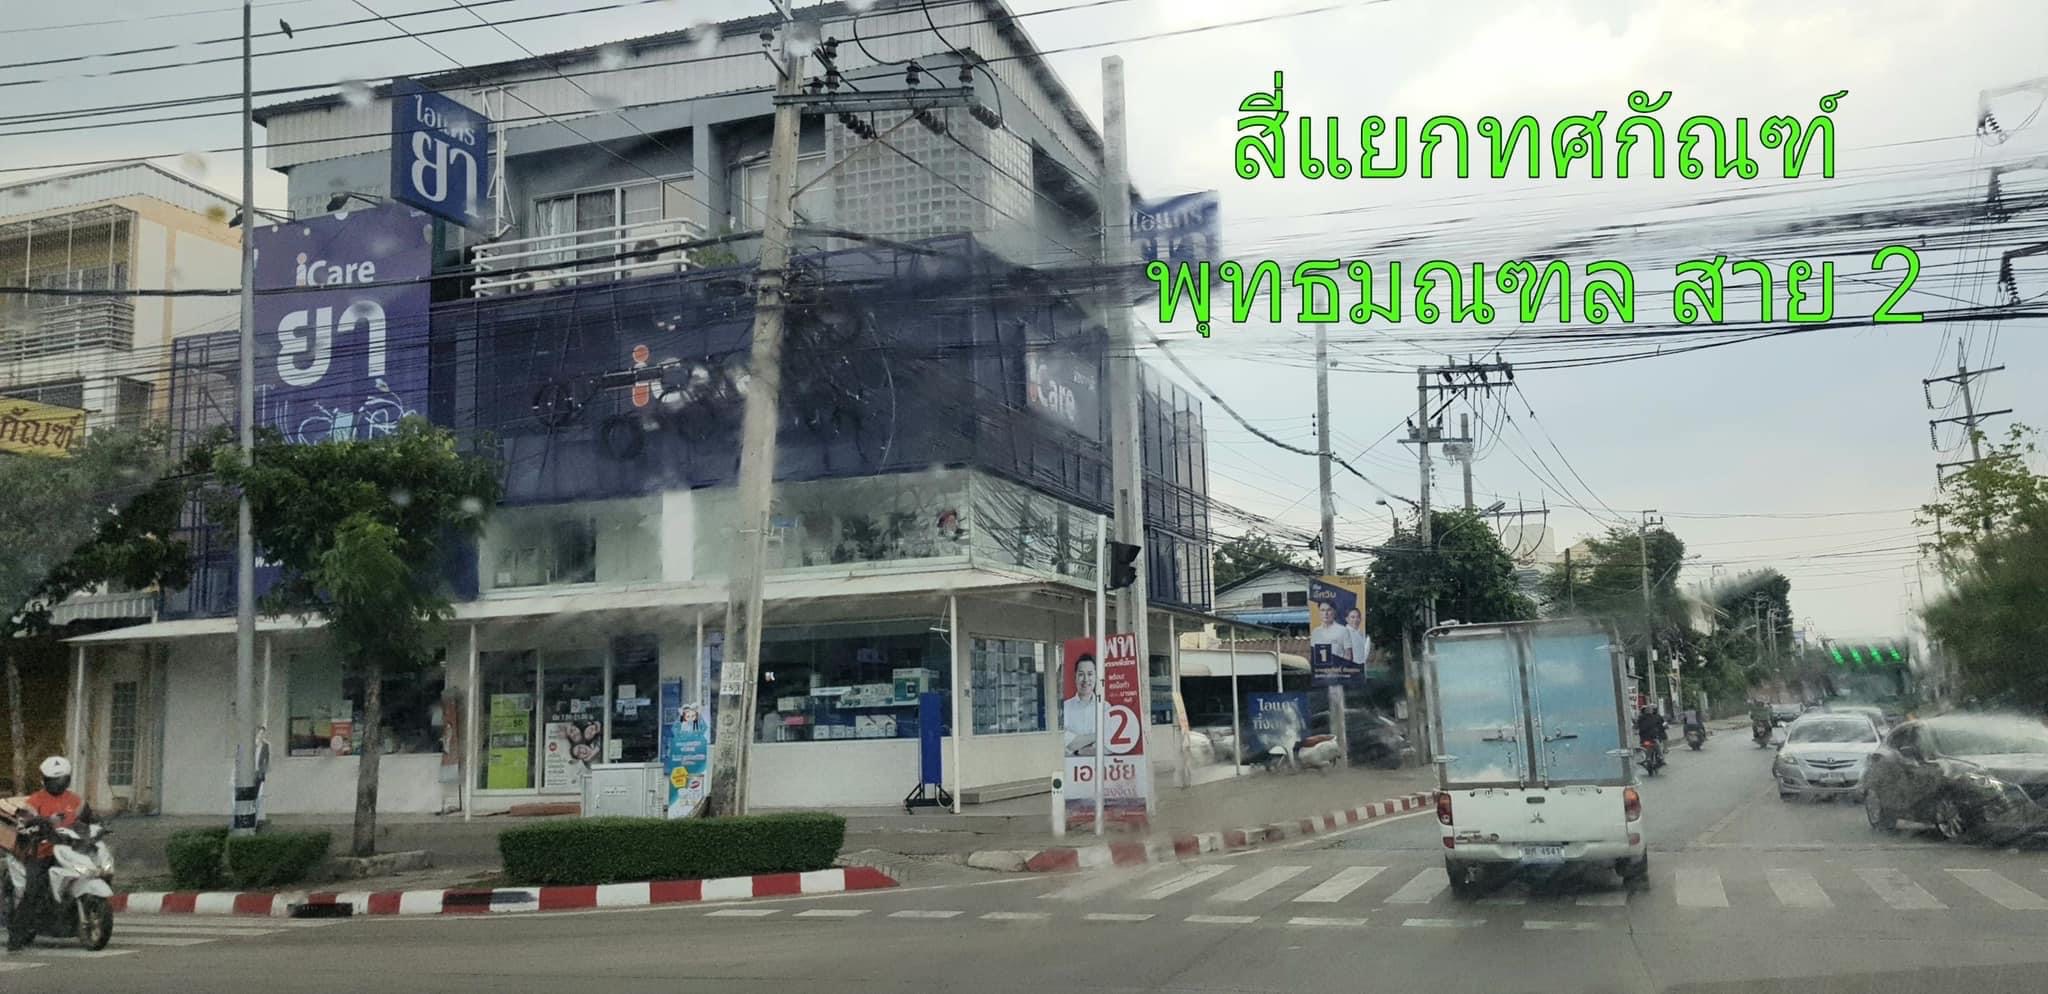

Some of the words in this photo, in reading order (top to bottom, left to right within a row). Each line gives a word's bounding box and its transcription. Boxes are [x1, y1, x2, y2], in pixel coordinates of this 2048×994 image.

[415, 94, 475, 147] ไอแร
[412, 131, 477, 217] ยา
[295, 252, 376, 287] iCare
[277, 301, 387, 387] ยา
[1319, 649, 1328, 662] 1
[1109, 709, 1132, 746] 2
